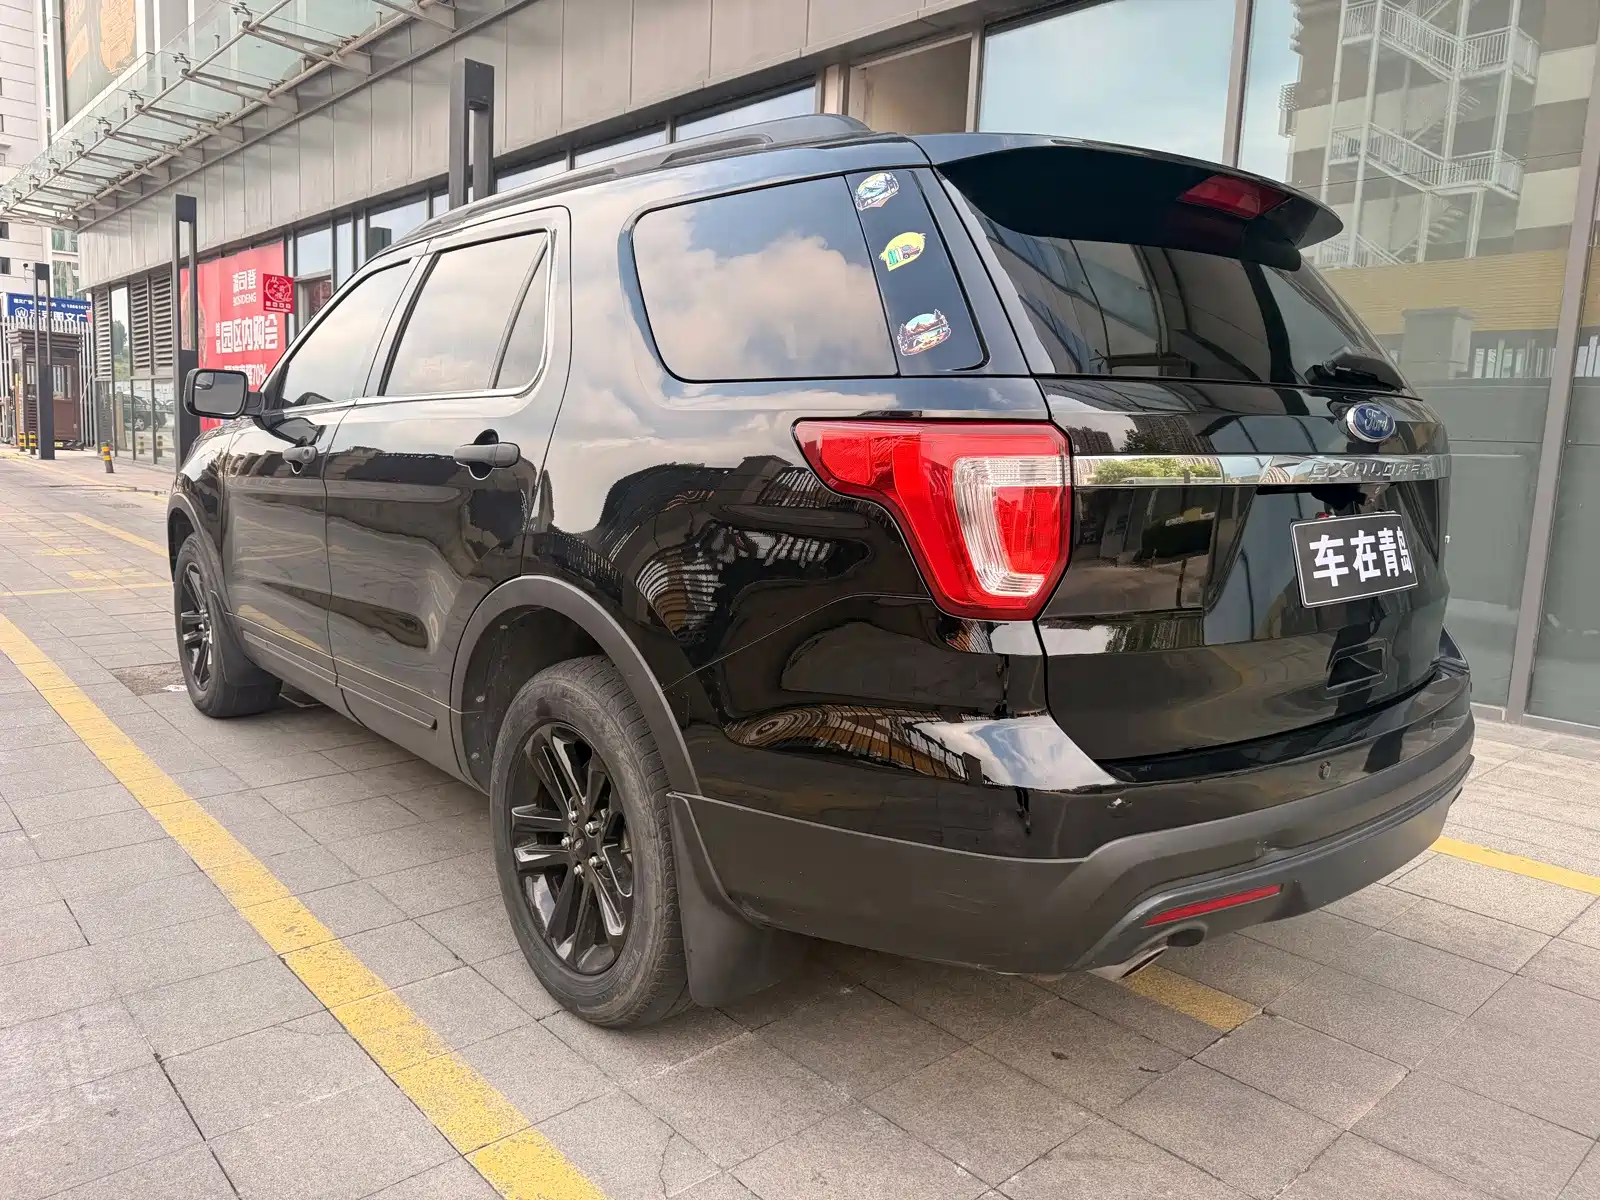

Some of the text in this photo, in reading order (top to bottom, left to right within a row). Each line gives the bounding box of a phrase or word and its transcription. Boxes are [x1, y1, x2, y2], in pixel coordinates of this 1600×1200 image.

[221, 313, 278, 354] 园区内购会
[1363, 407, 1390, 432] Ford
[1308, 525, 1413, 588] 车在青岛
